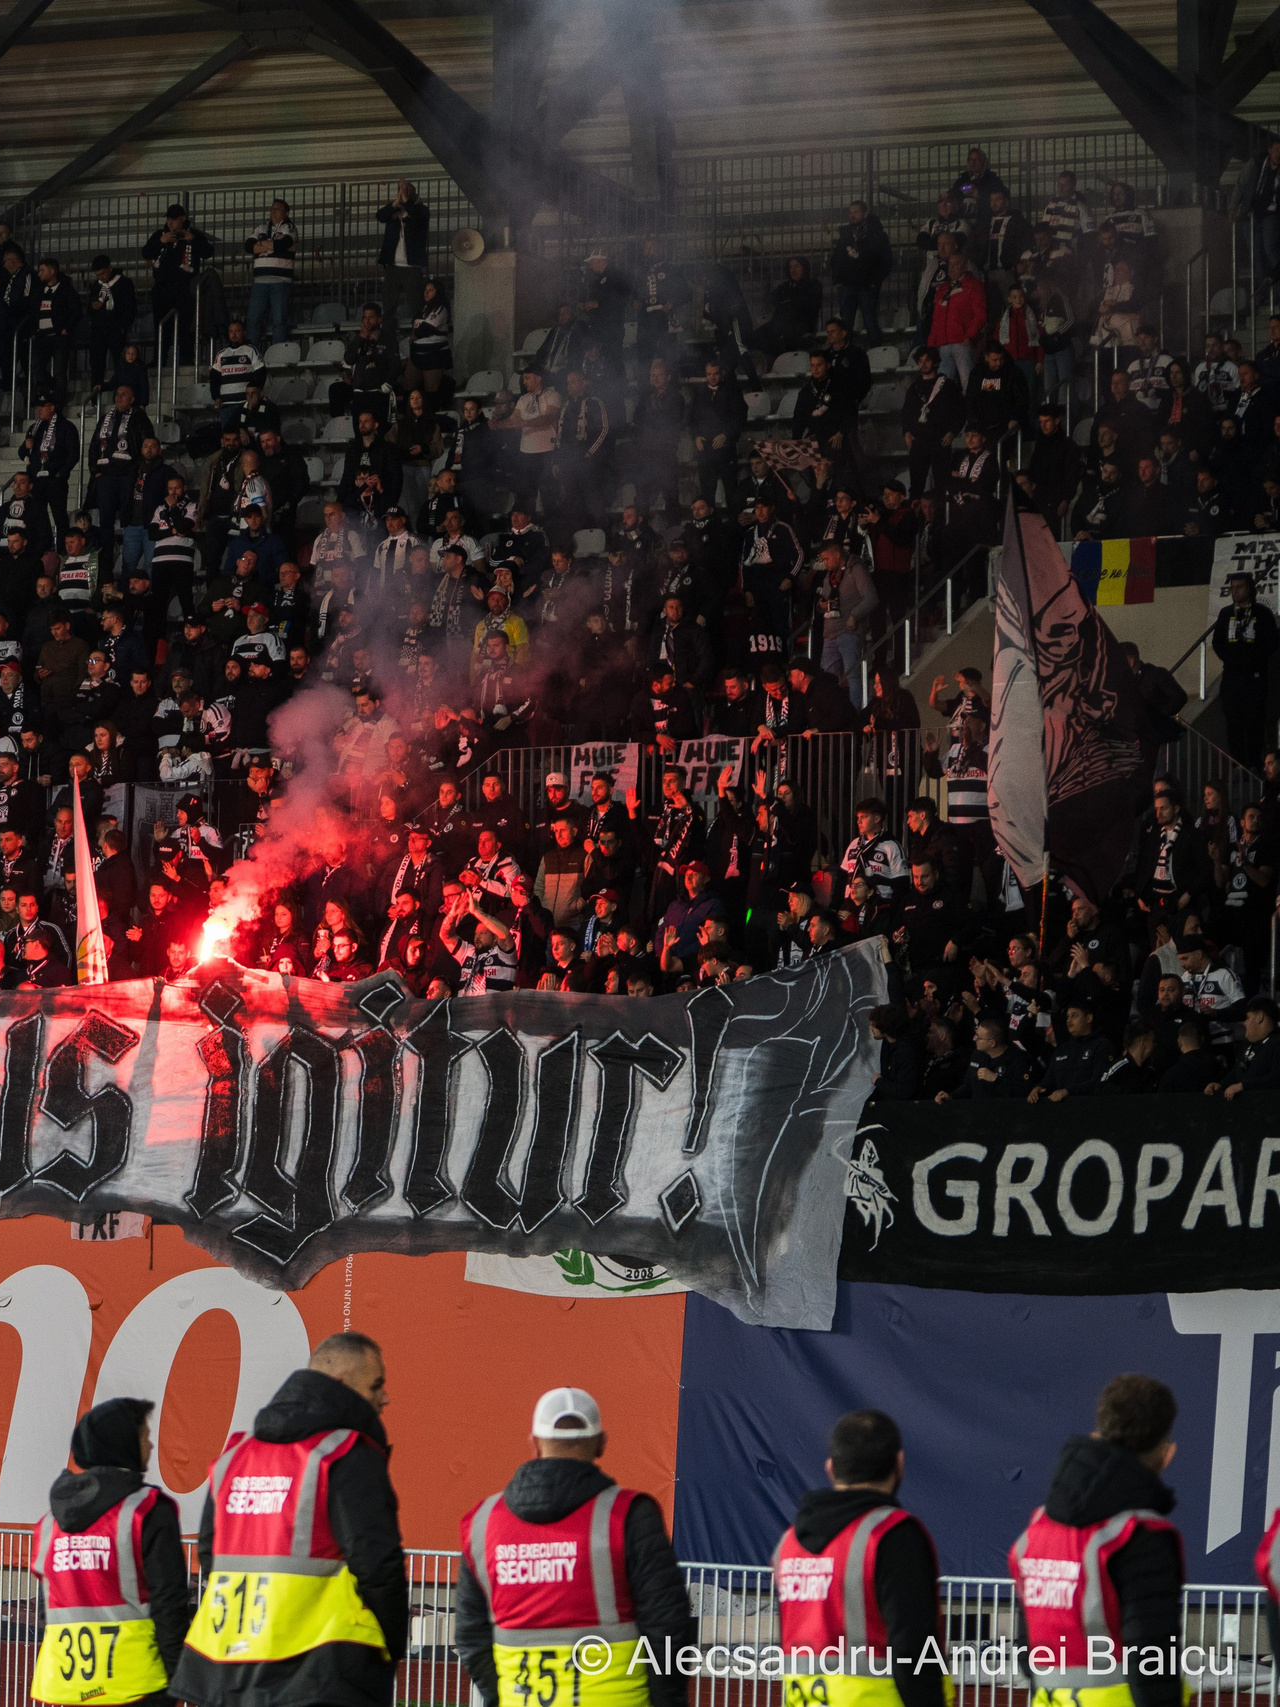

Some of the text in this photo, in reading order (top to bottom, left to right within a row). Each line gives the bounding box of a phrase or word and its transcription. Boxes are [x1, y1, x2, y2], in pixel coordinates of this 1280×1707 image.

[748, 634, 783, 653] 1919
[625, 1267, 654, 1279] 2008
[226, 1491, 289, 1515] SECURITY
[53, 1550, 111, 1572] SECURITY
[495, 1541, 577, 1561] SVS EXECUTION
[496, 1558, 577, 1585] SECURITY
[213, 1573, 270, 1635] 515
[58, 1625, 120, 1681] 397
